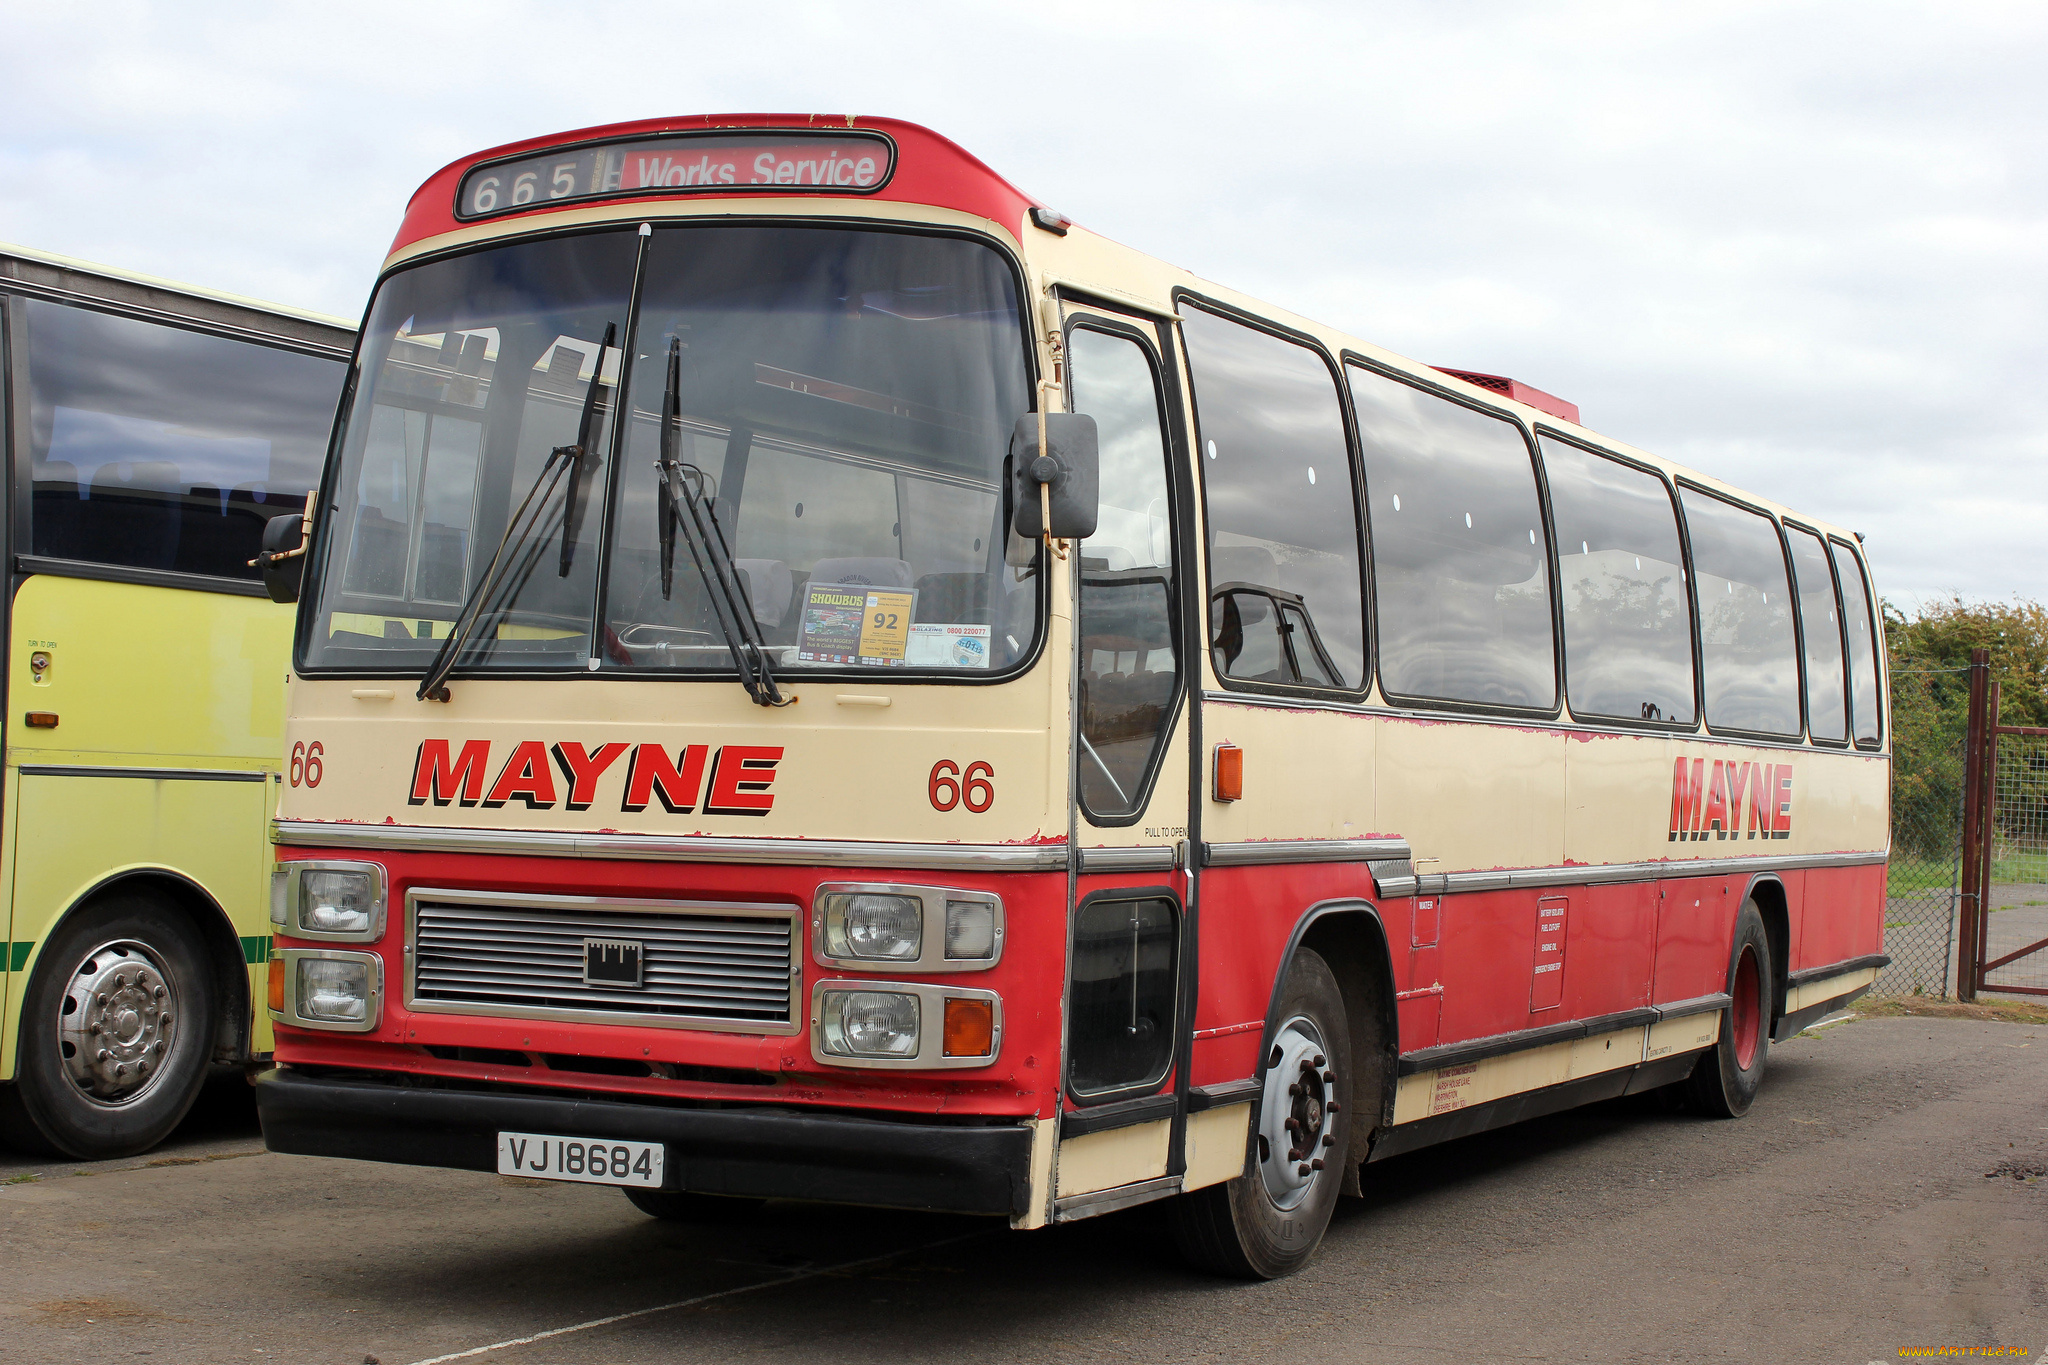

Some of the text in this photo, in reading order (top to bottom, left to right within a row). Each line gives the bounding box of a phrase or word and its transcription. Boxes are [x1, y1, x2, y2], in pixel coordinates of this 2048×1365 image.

[638, 155, 735, 188] Works
[750, 150, 876, 187] Service
[810, 593, 864, 607] SHOWBUS
[873, 612, 898, 630] 92
[947, 627, 962, 635] 0800
[963, 628, 986, 636] 220077
[289, 740, 324, 789] 66
[408, 738, 785, 817] MAYNE
[928, 759, 995, 814] 66
[1668, 757, 1793, 841] MAYNE
[1145, 826, 1187, 838] PULL TO OPEN
[1419, 900, 1434, 910] WATER
